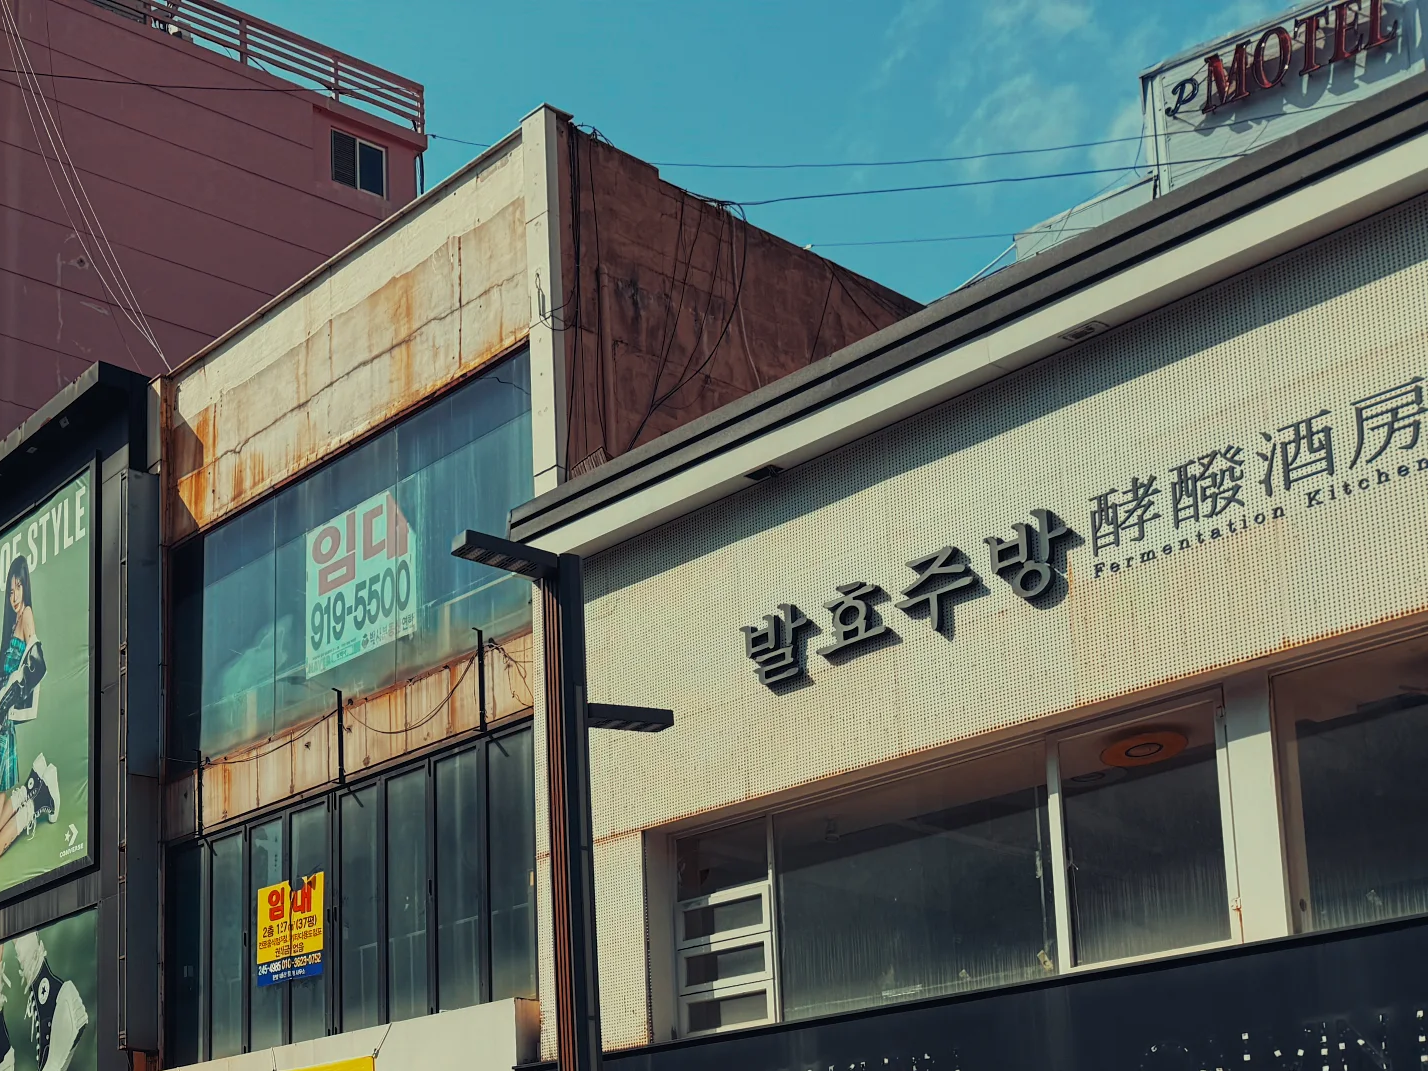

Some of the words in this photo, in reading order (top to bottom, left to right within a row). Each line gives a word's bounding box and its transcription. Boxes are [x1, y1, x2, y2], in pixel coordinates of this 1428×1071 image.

[1202, 0, 1399, 114] MOTEL
[0, 532, 22, 593] OF
[27, 486, 87, 573] STYLE
[311, 495, 409, 597] 임대
[1093, 503, 1286, 579] Fermentation
[1305, 457, 1428, 508] Kitchen
[310, 560, 411, 651] 919-5500
[739, 508, 1075, 685] 발효주방
[59, 842, 85, 859] CONVERSE
